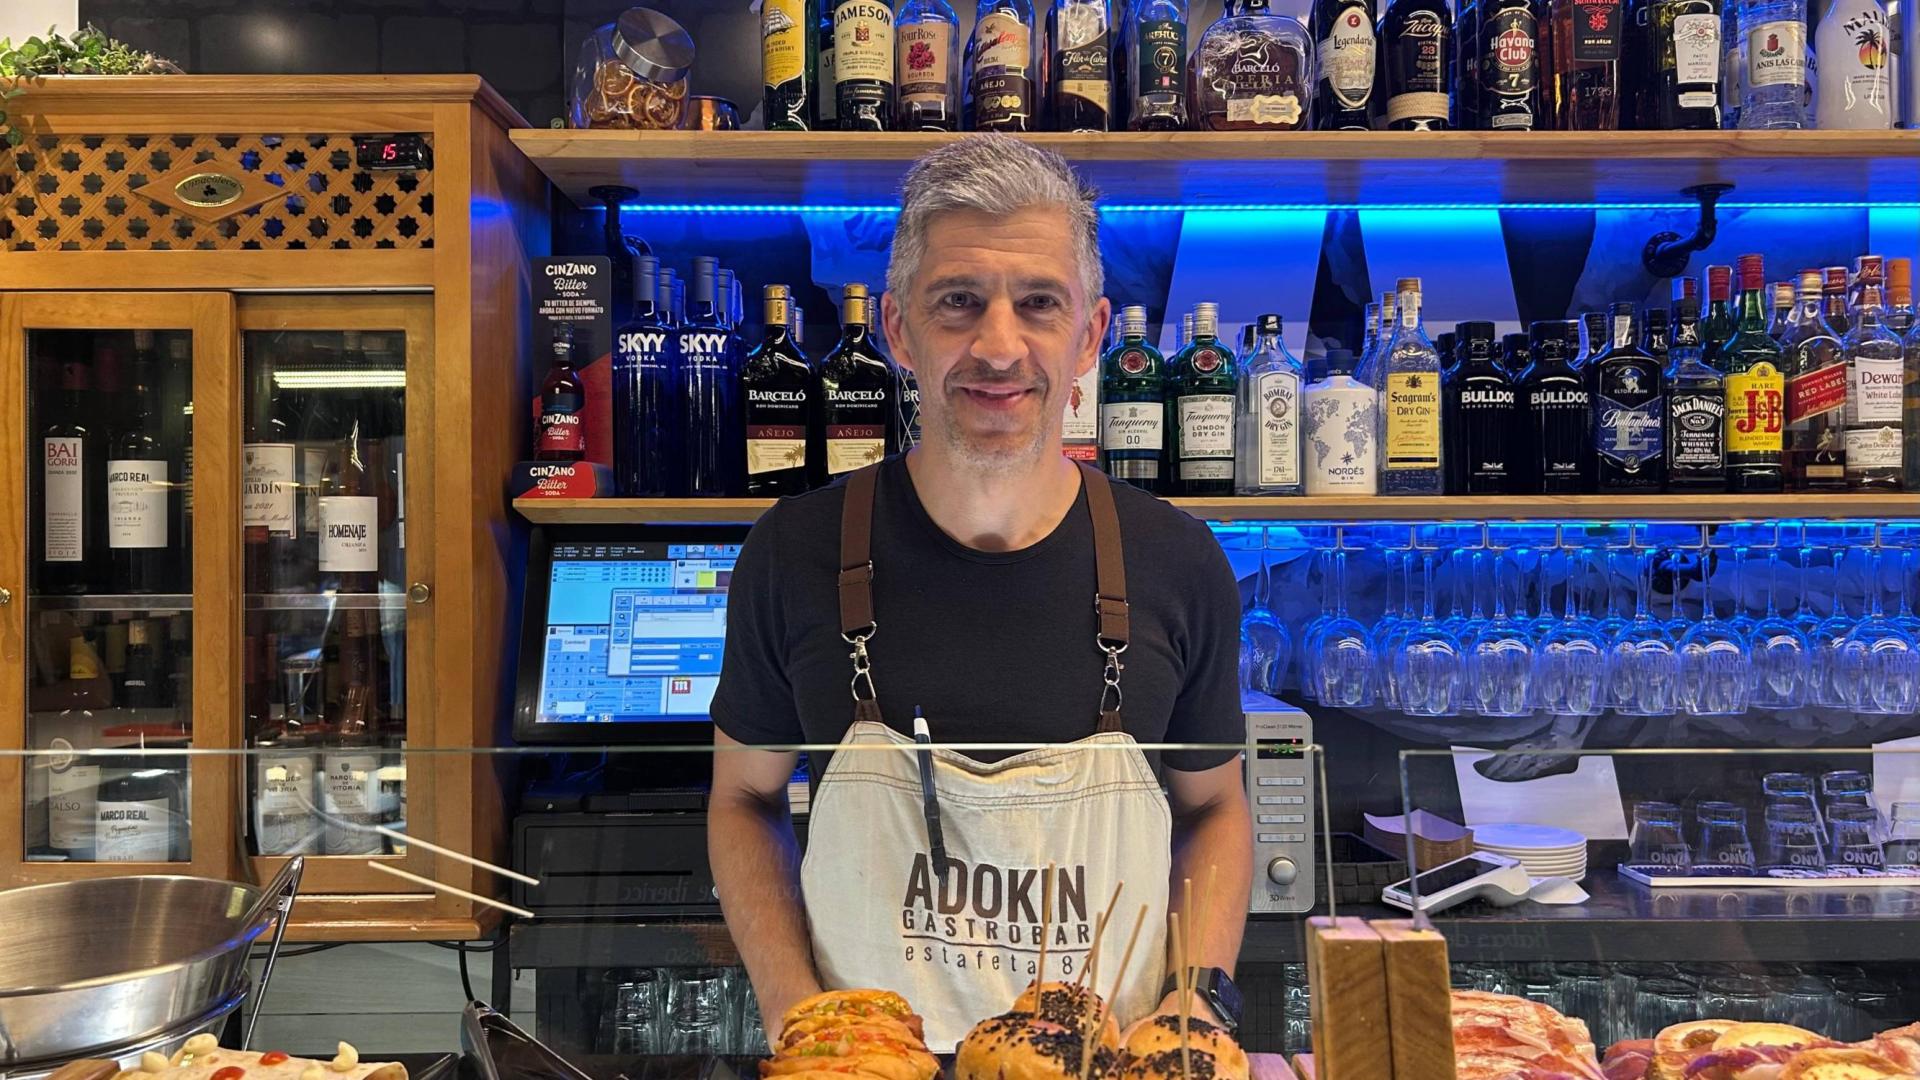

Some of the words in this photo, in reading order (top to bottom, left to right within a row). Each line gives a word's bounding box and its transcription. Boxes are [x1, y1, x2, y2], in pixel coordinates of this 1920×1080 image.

[836, 5, 890, 28] JAMESON
[1400, 20, 1448, 38] Zacapa
[1334, 34, 1372, 50] Legendario
[1490, 36, 1534, 50] Havana
[1062, 52, 1084, 66] Flor
[1161, 52, 1170, 66] 7
[1500, 48, 1527, 61] Club
[1234, 62, 1280, 74] BARCELÓ
[908, 72, 934, 80] BOURBON
[1508, 73, 1520, 88] 7
[383, 144, 396, 160] 15
[545, 263, 596, 276] CINZANO
[554, 278, 588, 290] Bitter
[539, 306, 554, 314] AHORA
[556, 306, 565, 314] CON
[566, 306, 581, 314] NUEVO
[582, 306, 604, 314] FORMATO
[618, 334, 666, 354] SKYY
[680, 334, 727, 354] SKYY
[1798, 387, 1817, 398] RED
[1820, 377, 1846, 391] LABEL
[748, 390, 806, 402] BARCELÓ
[828, 388, 885, 402] BARCELÓ
[1264, 388, 1294, 402] BOMBAY
[1391, 392, 1436, 405] Seagram's
[1530, 392, 1588, 404] BULLDOG
[1866, 391, 1888, 399] White
[1396, 406, 1414, 416] DRY
[1416, 406, 1430, 416] GIN
[1672, 401, 1692, 417] JACK
[1693, 398, 1724, 417] DANIEL'S
[542, 414, 579, 424] CINZANO
[1108, 416, 1158, 430] Tanqueray
[1186, 411, 1230, 422] Tanqueray
[1600, 408, 1661, 428] Ballantine's
[548, 427, 570, 436] Bitter
[758, 428, 794, 437] AÑEJO
[837, 428, 873, 437] AÑEJO
[1265, 420, 1278, 432] DRY
[1280, 420, 1293, 431] GIN
[47, 443, 77, 457] BAI
[47, 458, 77, 467] GORRI
[130, 472, 152, 483] REAL
[530, 466, 575, 477] CINZANO
[1328, 467, 1364, 476] NORDÉS
[244, 482, 282, 494] JARDÍN
[538, 479, 567, 490] Bitter
[328, 524, 366, 540] HOMENAJE
[100, 810, 125, 821] MARCO
[126, 810, 149, 820] REAL
[904, 852, 1088, 924] ADOKIN
[902, 909, 1090, 945] GASTROBAR
[905, 946, 1036, 974] estafeta
